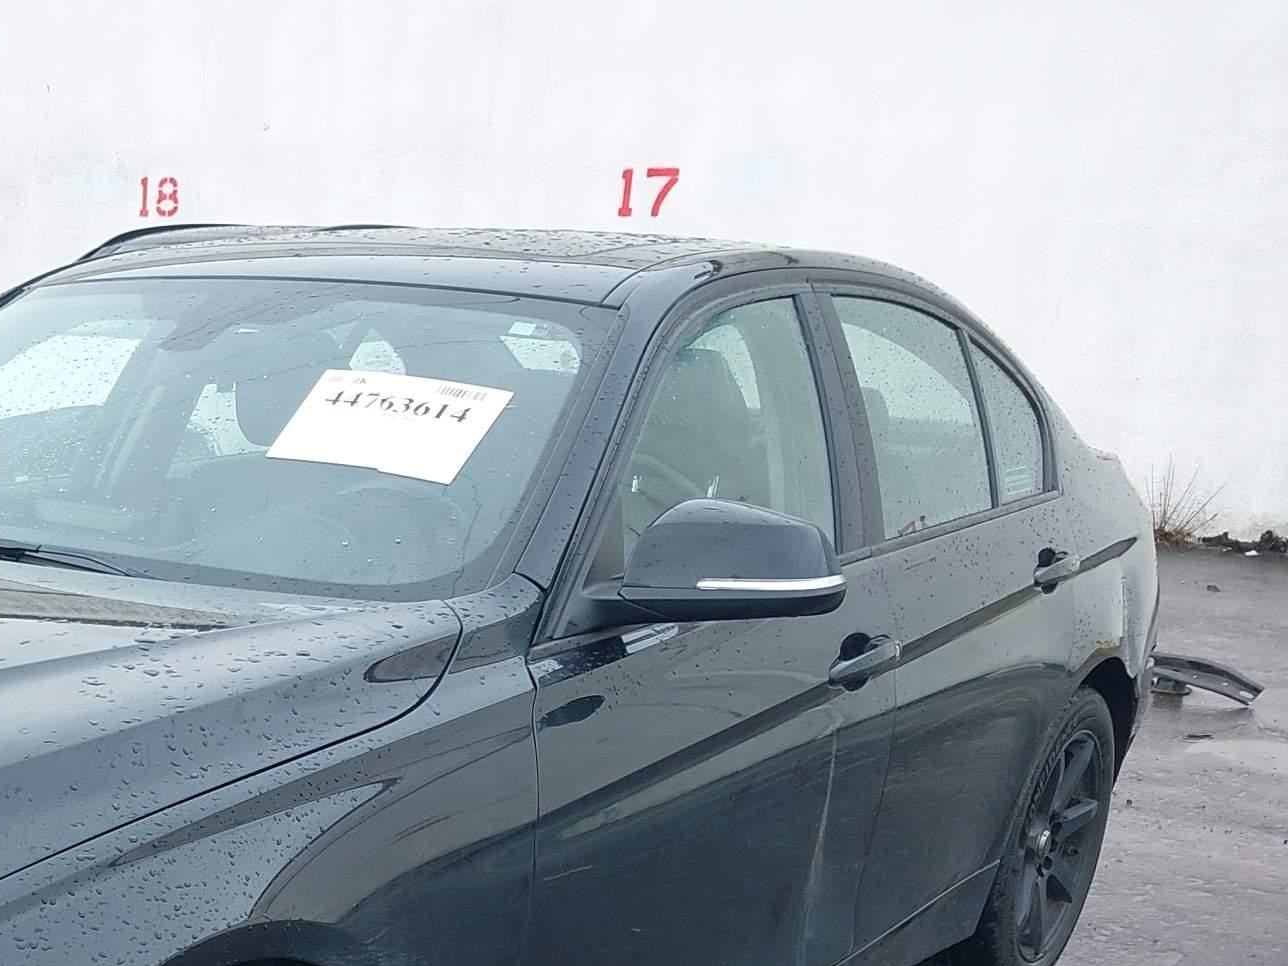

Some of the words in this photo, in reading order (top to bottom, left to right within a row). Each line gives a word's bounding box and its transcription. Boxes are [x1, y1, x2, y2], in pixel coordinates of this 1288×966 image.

[139, 176, 179, 217] 18
[618, 168, 680, 217] 17
[325, 391, 472, 423] 44763614
